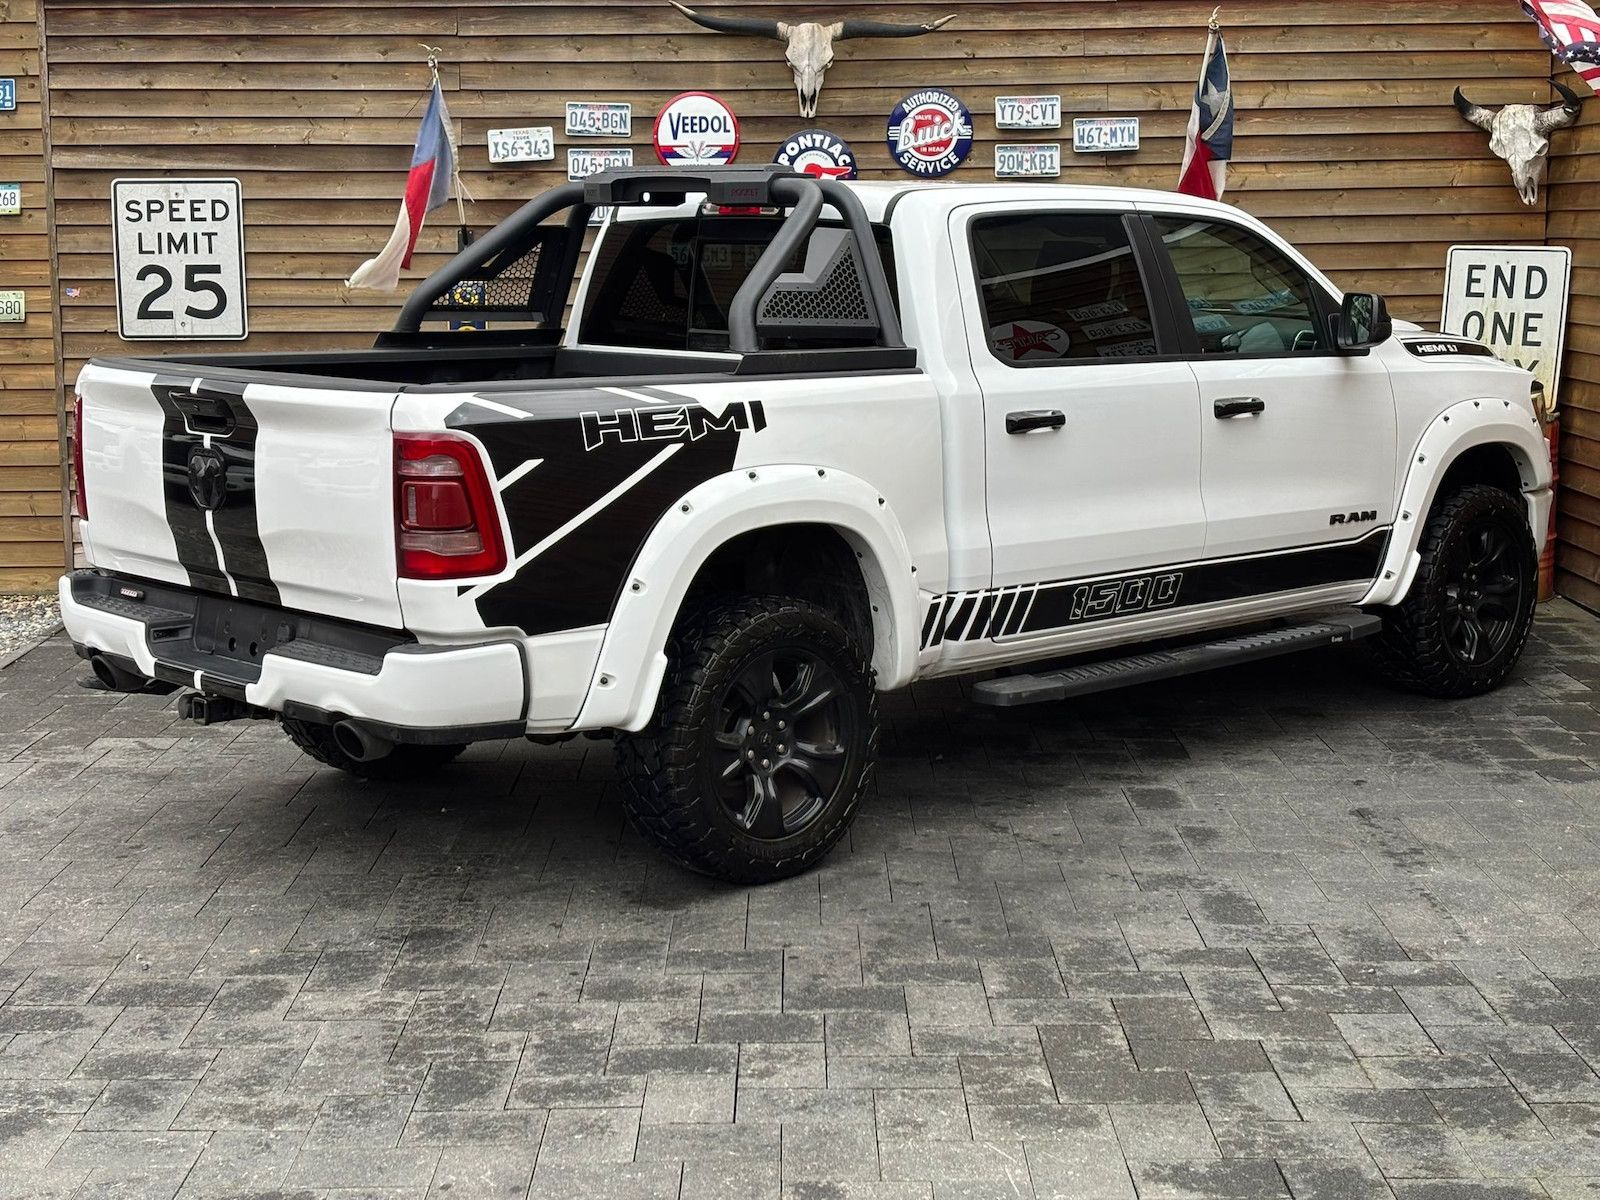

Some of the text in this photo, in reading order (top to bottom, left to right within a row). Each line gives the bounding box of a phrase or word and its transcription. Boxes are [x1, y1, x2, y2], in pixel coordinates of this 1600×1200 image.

[902, 91, 959, 113] AUTHORIZED
[1031, 104, 1056, 120] CVT
[602, 112, 627, 129] BGN
[668, 112, 731, 140] VEEDOL
[896, 110, 969, 153] Buick
[778, 134, 852, 166] PONTIAC
[900, 152, 959, 173] SERVICE
[0, 191, 16, 206] 68
[125, 199, 230, 223] SPEED
[137, 232, 218, 255] LIMIT
[136, 264, 228, 320] 25
[1465, 264, 1548, 300] END
[1462, 310, 1544, 347] ONE
[1416, 344, 1447, 354] HEMI
[579, 400, 768, 451] HEMI
[1329, 510, 1377, 526] RAM
[1068, 572, 1184, 620] 1500
